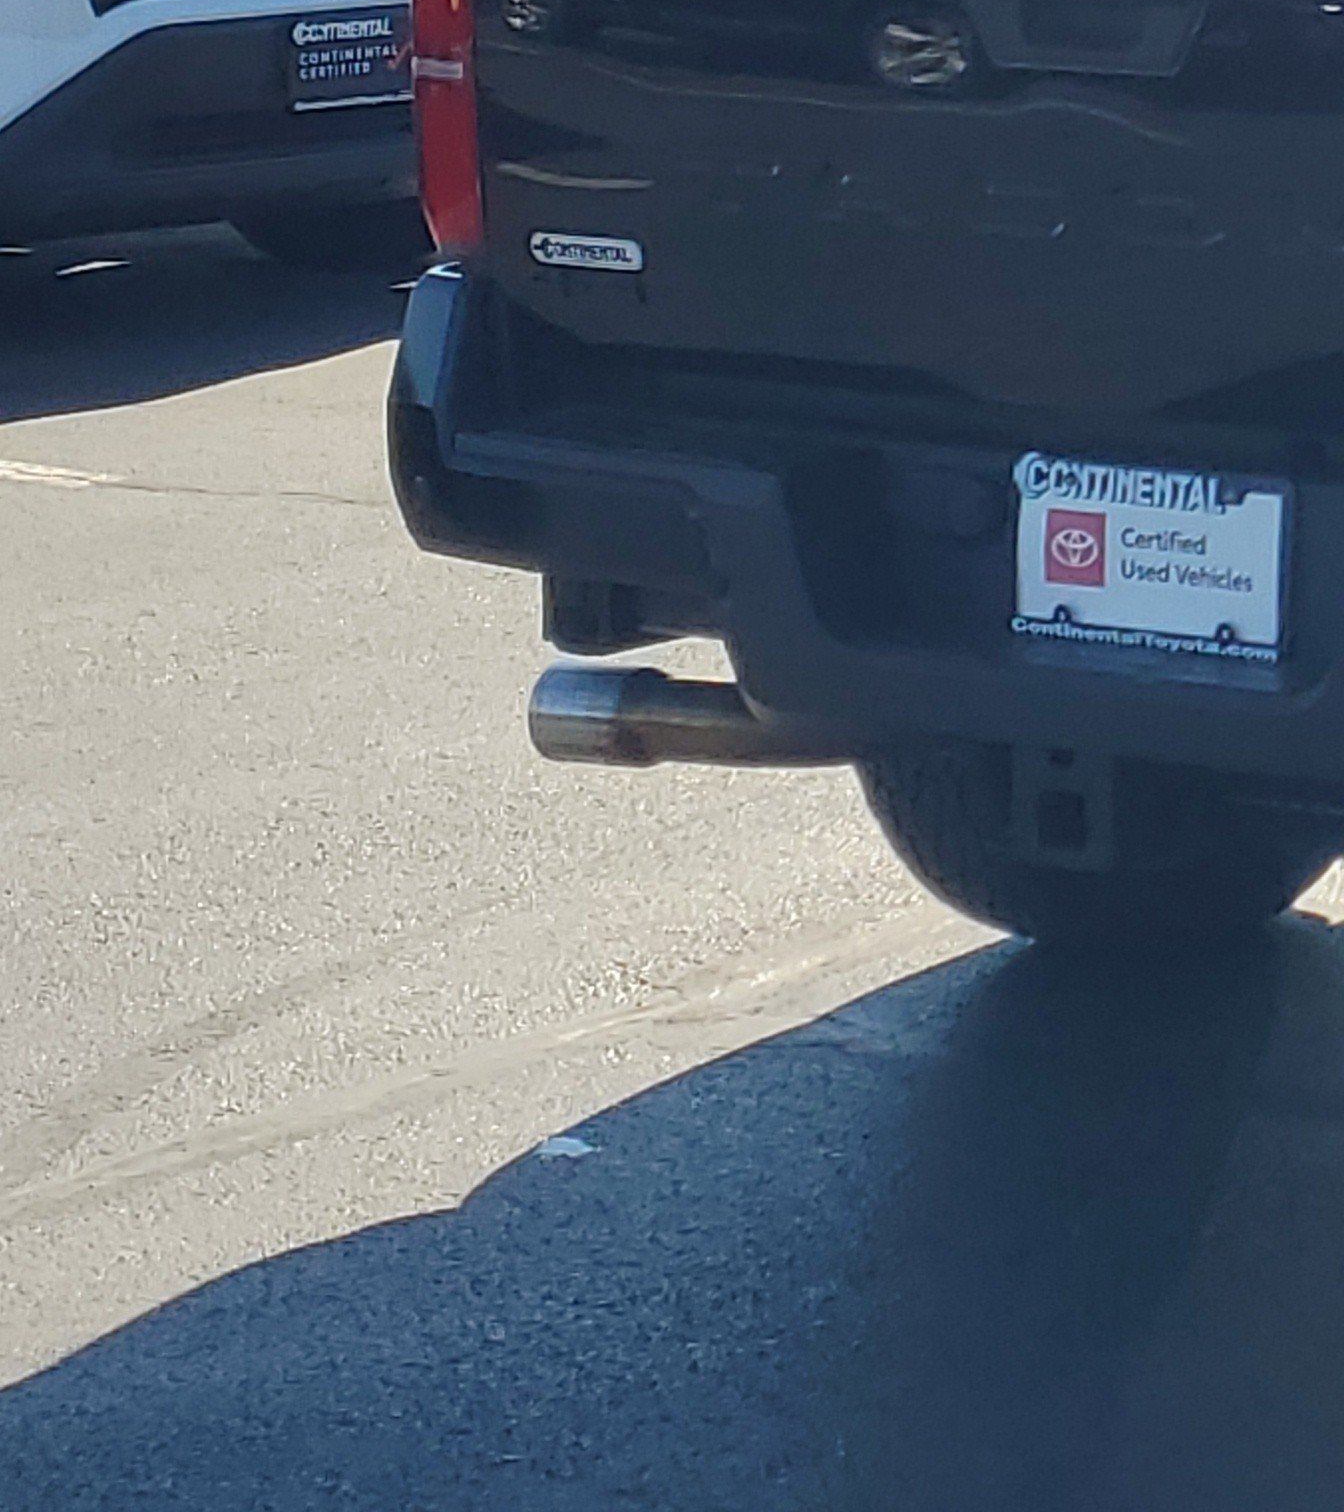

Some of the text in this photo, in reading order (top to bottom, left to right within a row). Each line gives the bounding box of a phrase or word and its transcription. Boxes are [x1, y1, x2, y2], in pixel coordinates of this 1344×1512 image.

[292, 17, 393, 45] CONTINENTAL
[299, 44, 397, 65] CONTINENTAL
[299, 61, 370, 80] CERTIFIED
[1013, 451, 1226, 515] CONTINENTAL
[1121, 526, 1207, 555] Certified
[1121, 560, 1253, 593] Used Vehicles
